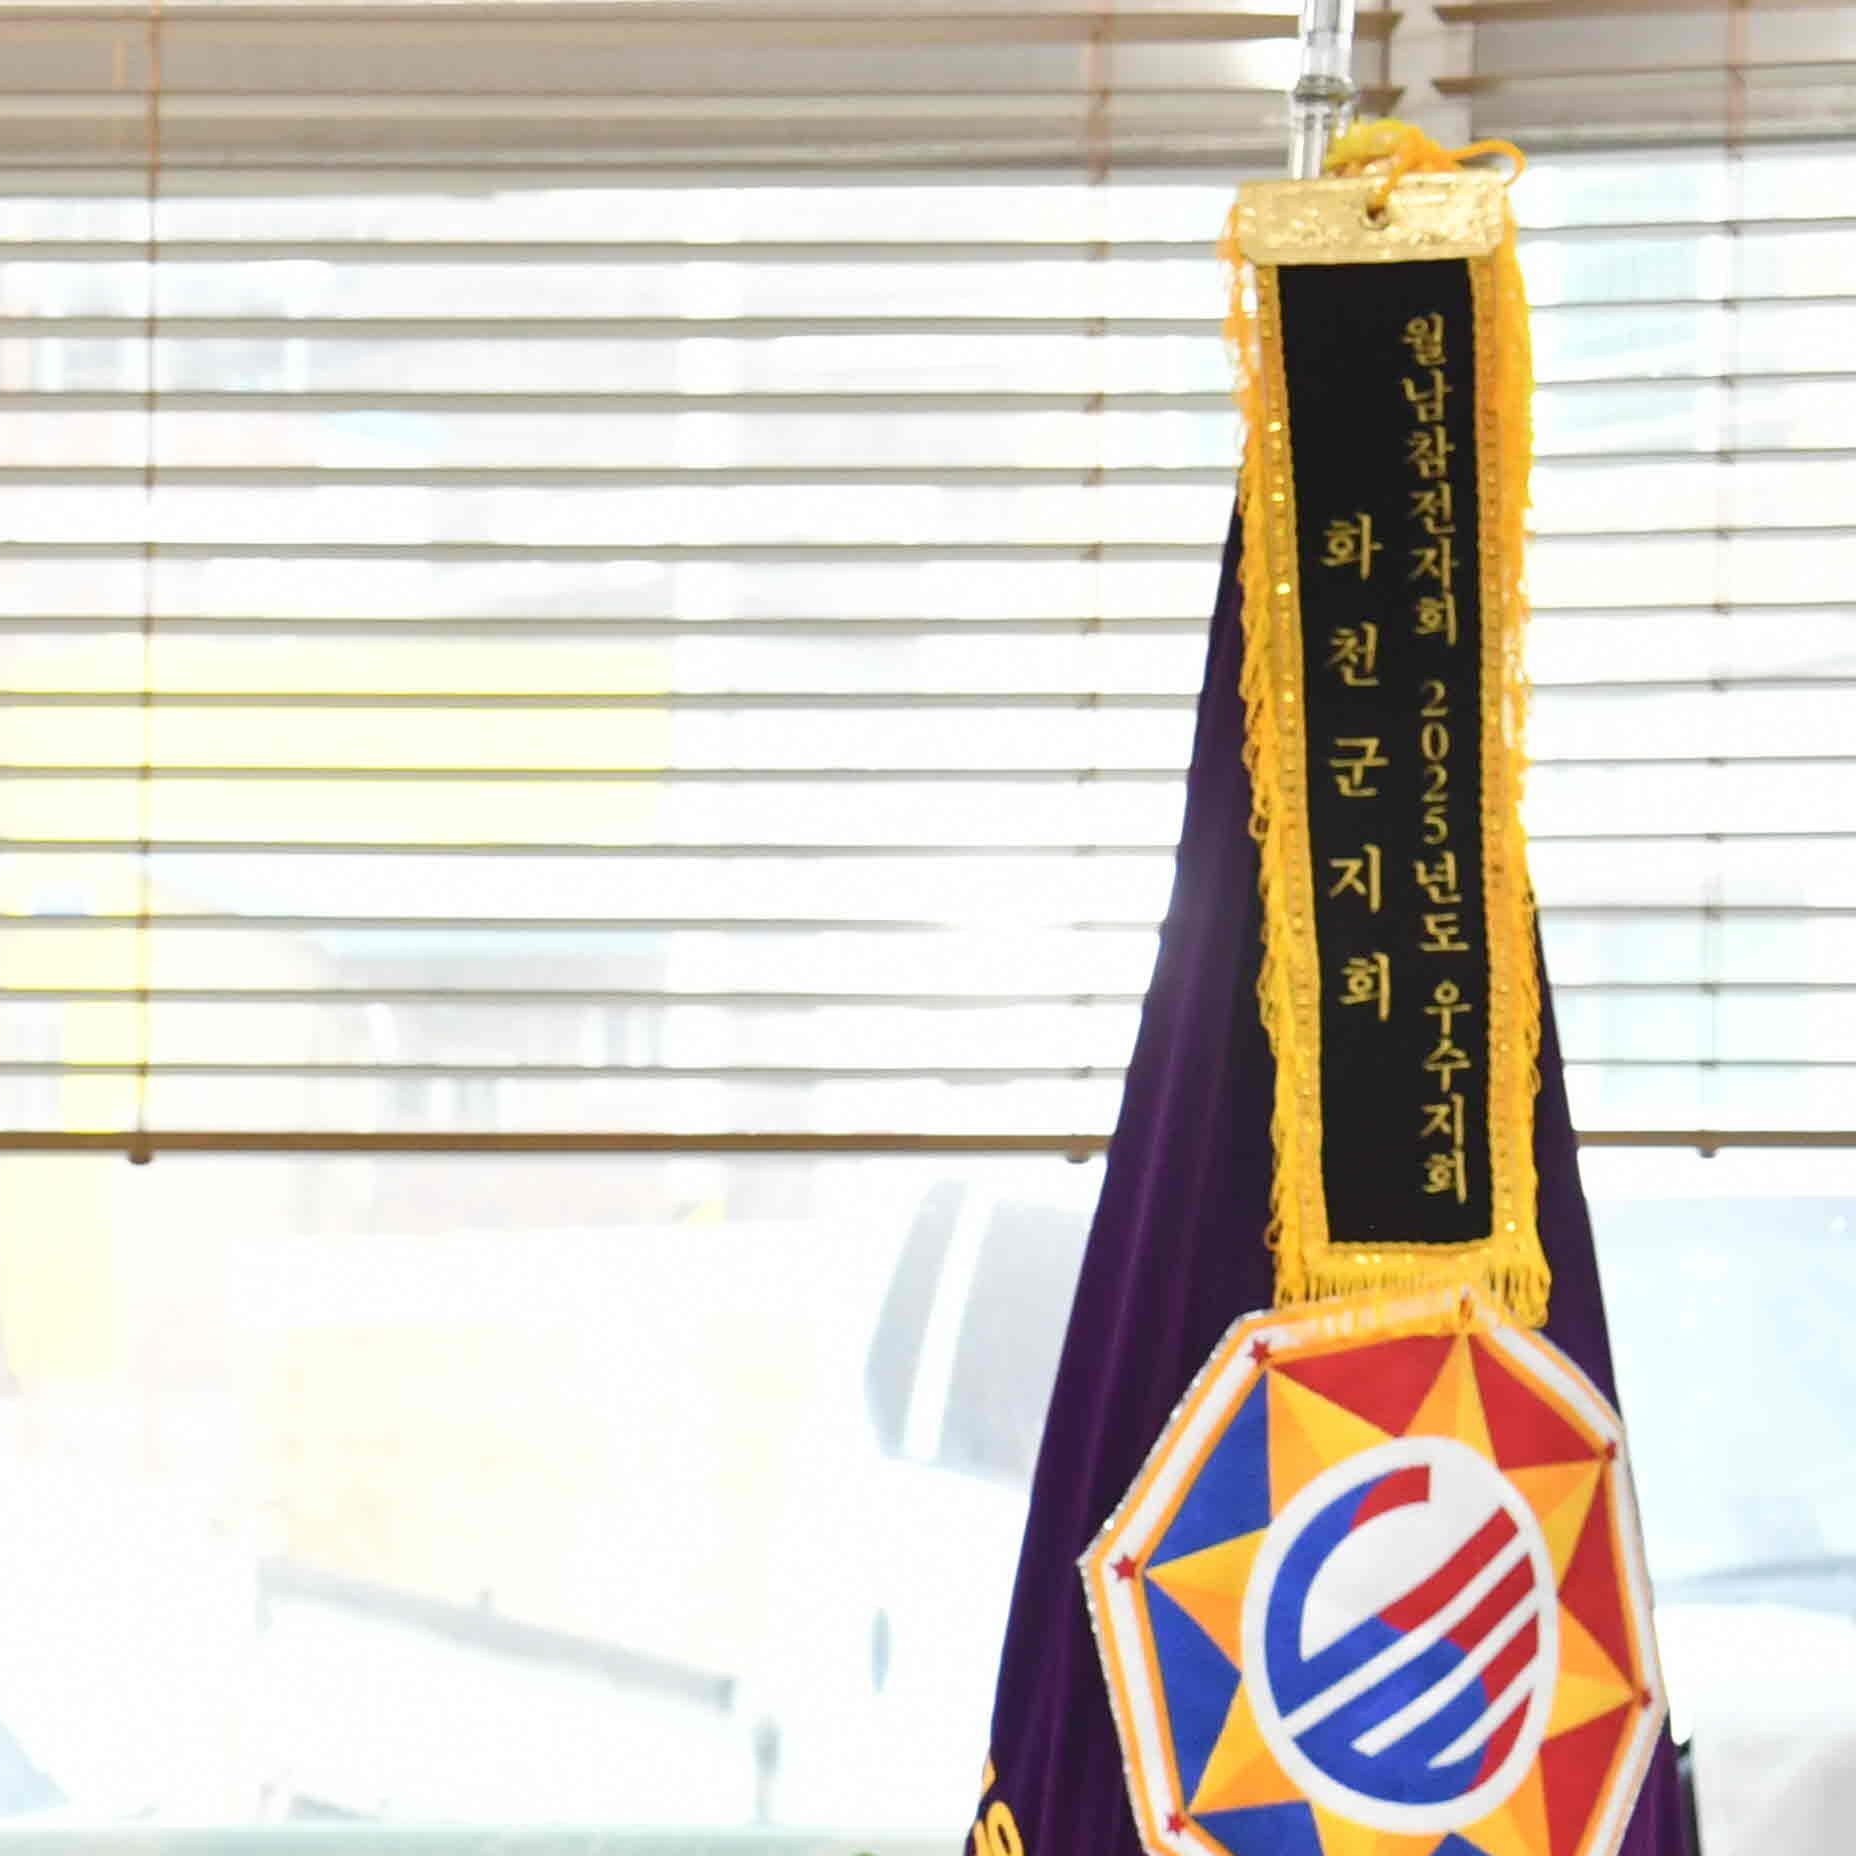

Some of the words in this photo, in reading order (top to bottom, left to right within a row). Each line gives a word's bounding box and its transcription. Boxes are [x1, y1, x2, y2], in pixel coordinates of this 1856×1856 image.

[1401, 311, 1459, 648] 월남참전자회
[1322, 512, 1393, 1023] 화천군지회
[1414, 679, 1465, 953] 2025년도
[1420, 979, 1472, 1205] 우수지회
